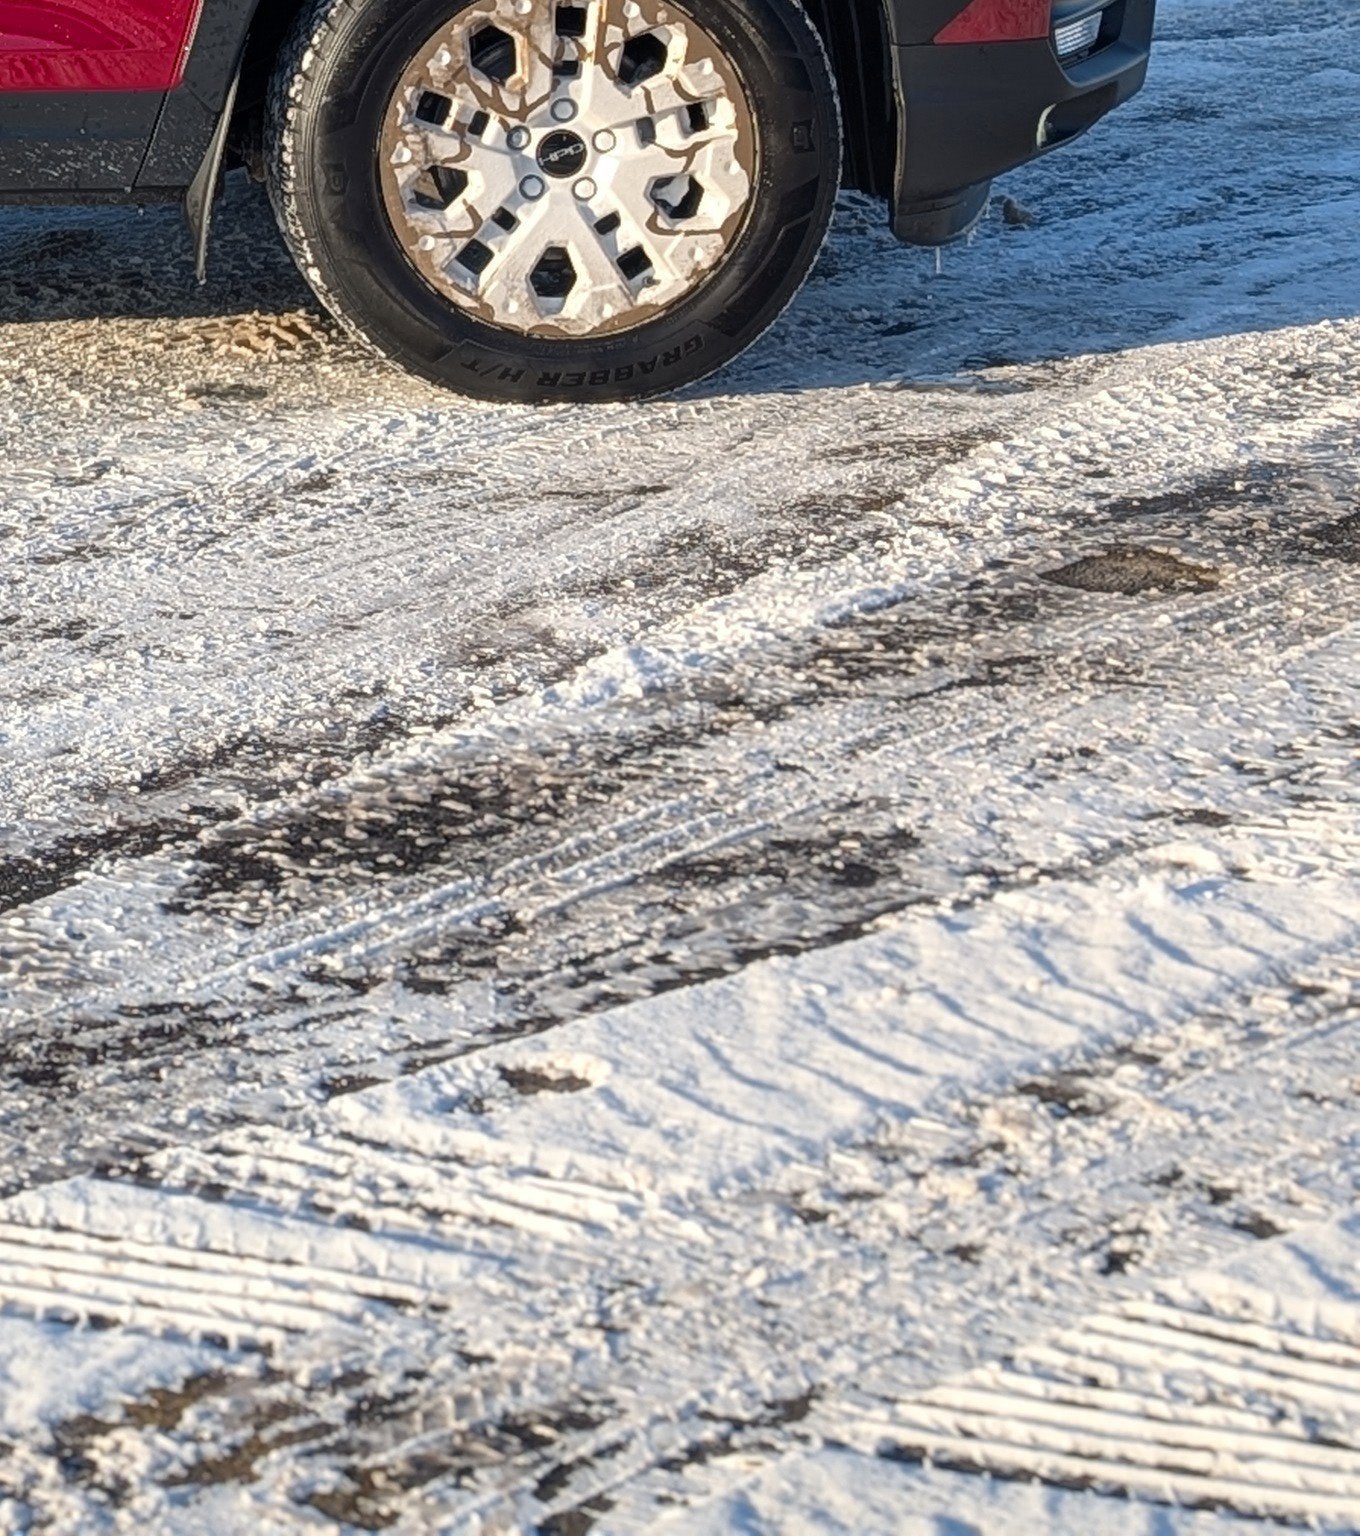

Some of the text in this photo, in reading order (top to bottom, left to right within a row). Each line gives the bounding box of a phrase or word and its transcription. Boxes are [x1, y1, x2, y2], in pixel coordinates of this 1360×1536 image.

[538, 143, 584, 166] HPD
[461, 358, 527, 383] H/T
[535, 333, 706, 388] GRABBER
